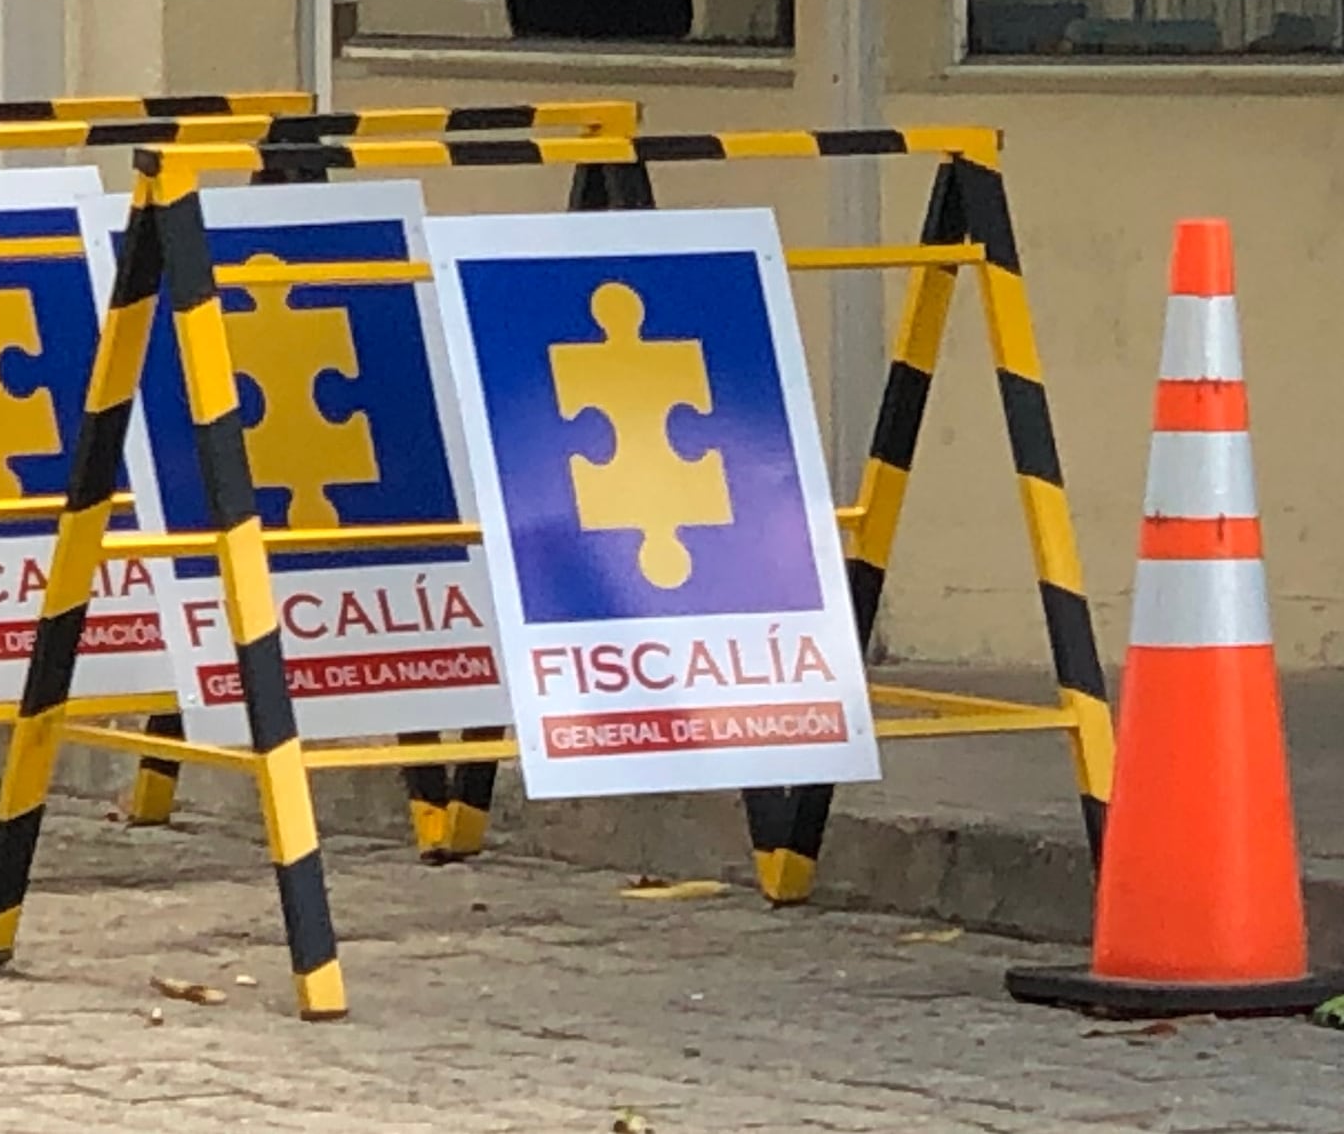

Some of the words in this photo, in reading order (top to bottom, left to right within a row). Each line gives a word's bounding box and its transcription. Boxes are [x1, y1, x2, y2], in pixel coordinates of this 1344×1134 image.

[182, 573, 484, 647] FCALÍA
[207, 669, 323, 697] GEAL
[325, 665, 361, 688] DE
[364, 663, 396, 684] LA
[399, 654, 491, 681] NACIÓN
[530, 623, 837, 696] FISCALÍA
[550, 722, 669, 750] GENERAL
[672, 719, 708, 744] DE
[711, 718, 743, 740] LA
[745, 706, 839, 739] NACIÓN
